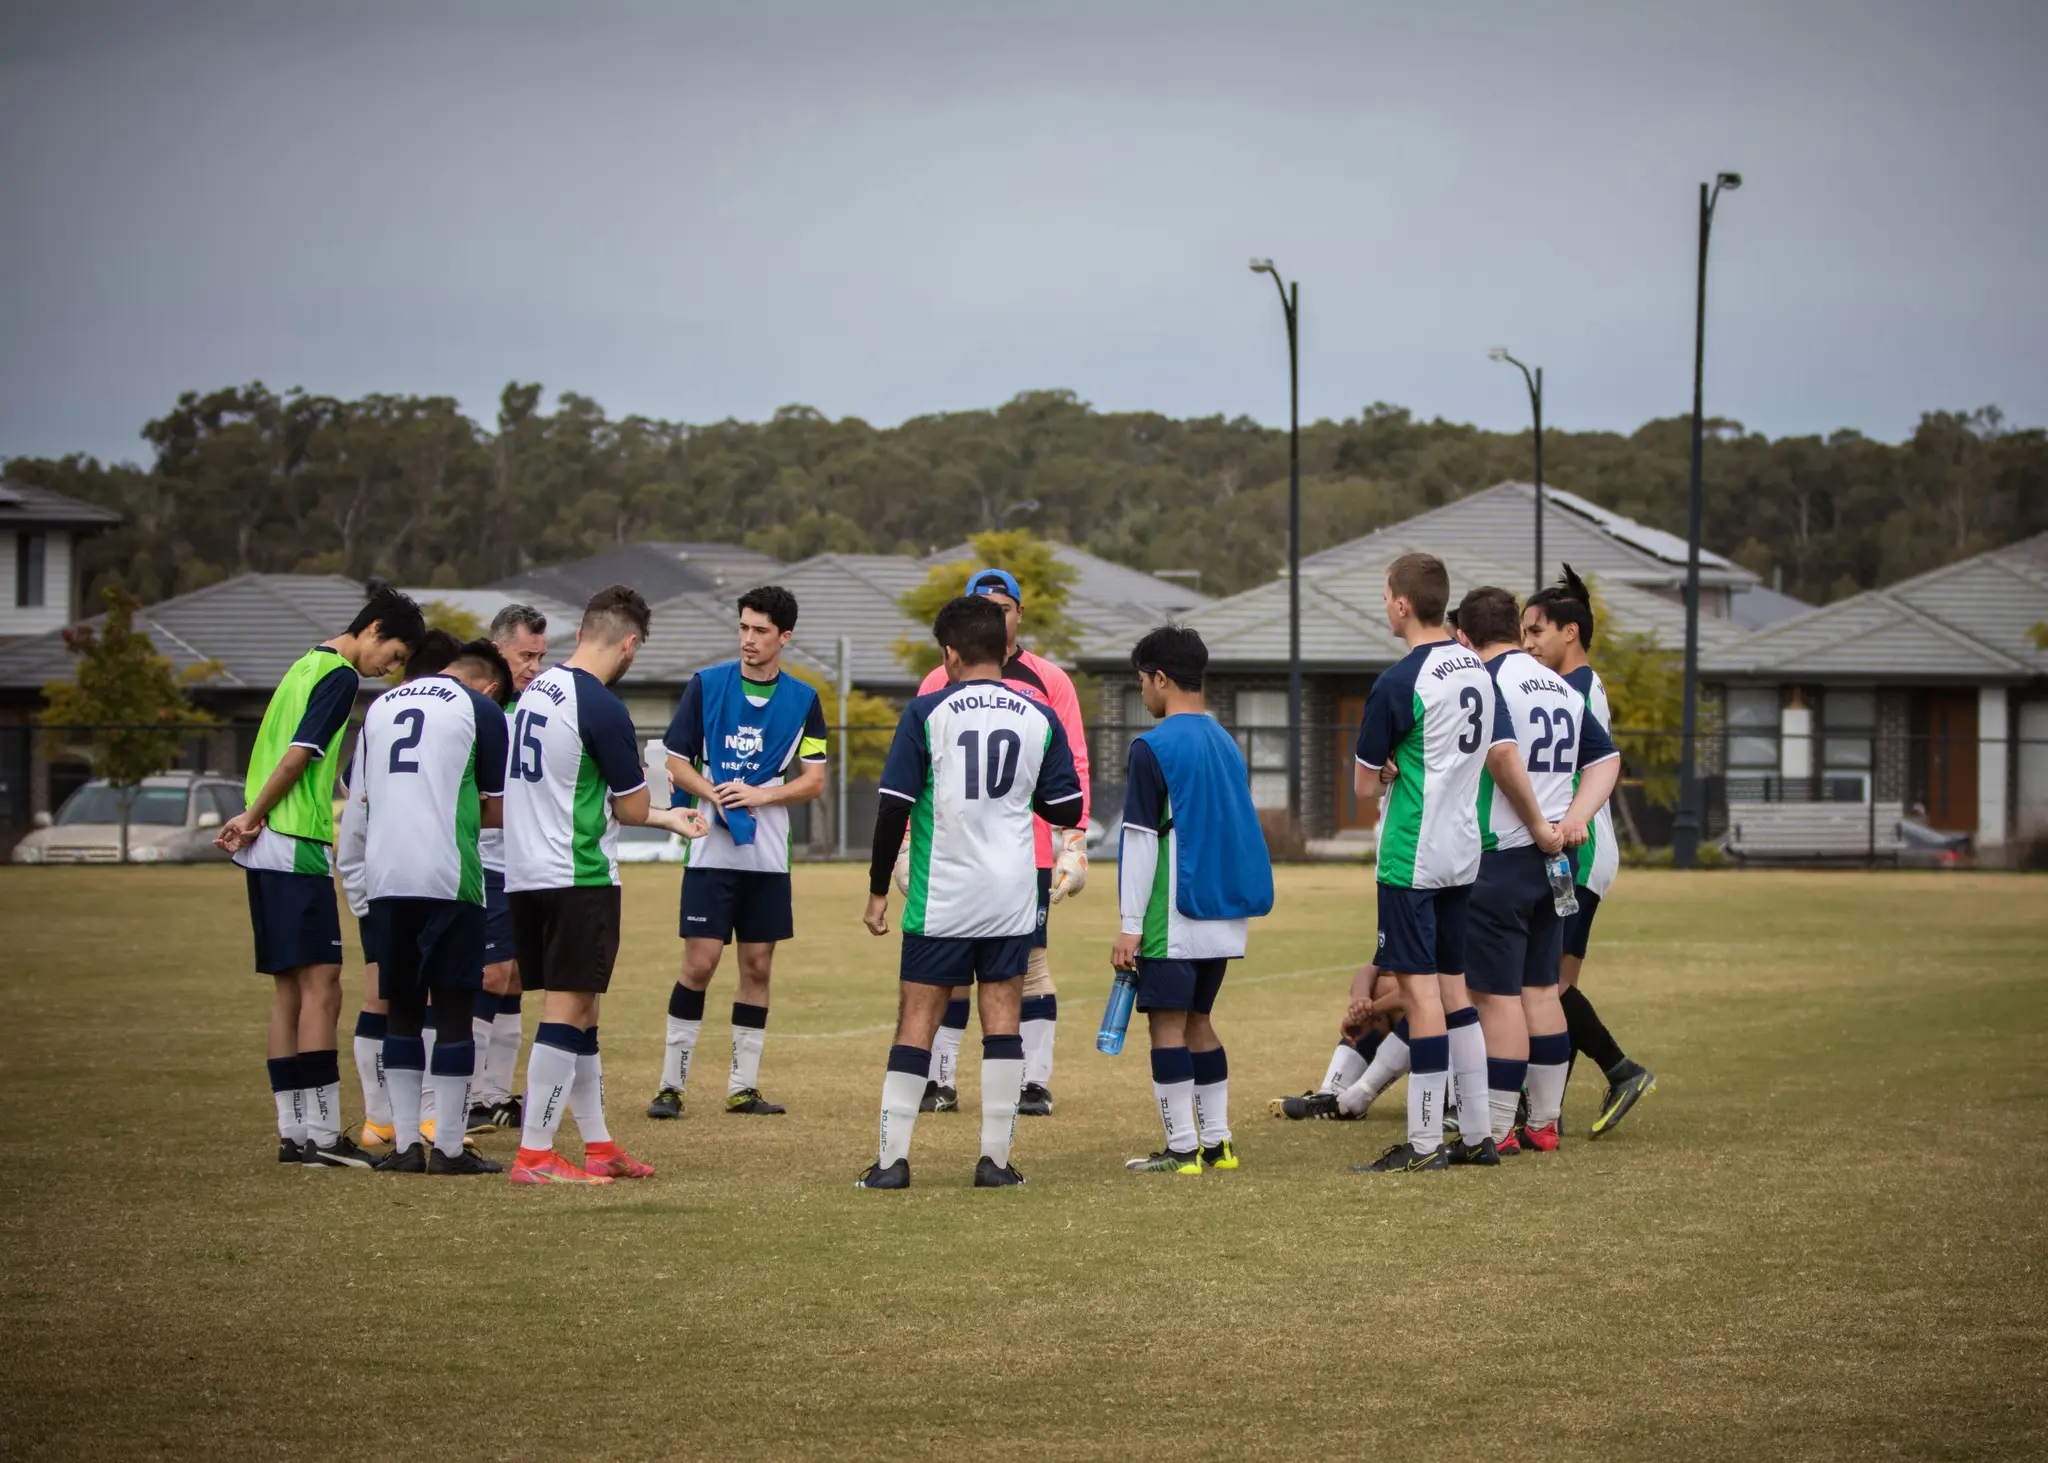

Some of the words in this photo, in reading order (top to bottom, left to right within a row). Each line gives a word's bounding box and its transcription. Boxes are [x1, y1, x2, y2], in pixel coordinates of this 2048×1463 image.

[1432, 657, 1485, 681] WOLLEM
[1519, 678, 1569, 699] WOLLEMI
[385, 686, 457, 703] WOLLEMI
[949, 695, 1027, 716] WOLLEMI
[1458, 686, 1484, 754] 3
[1527, 706, 1576, 773] 22
[389, 708, 425, 774] 2
[510, 708, 549, 784] 15
[957, 728, 1022, 800] 10
[316, 1087, 328, 1121] OLLEMI
[543, 1085, 563, 1127] WOLLEMI
[1161, 1096, 1173, 1135] WOLLEMI
[1423, 1090, 1432, 1128] WOLLEMI
